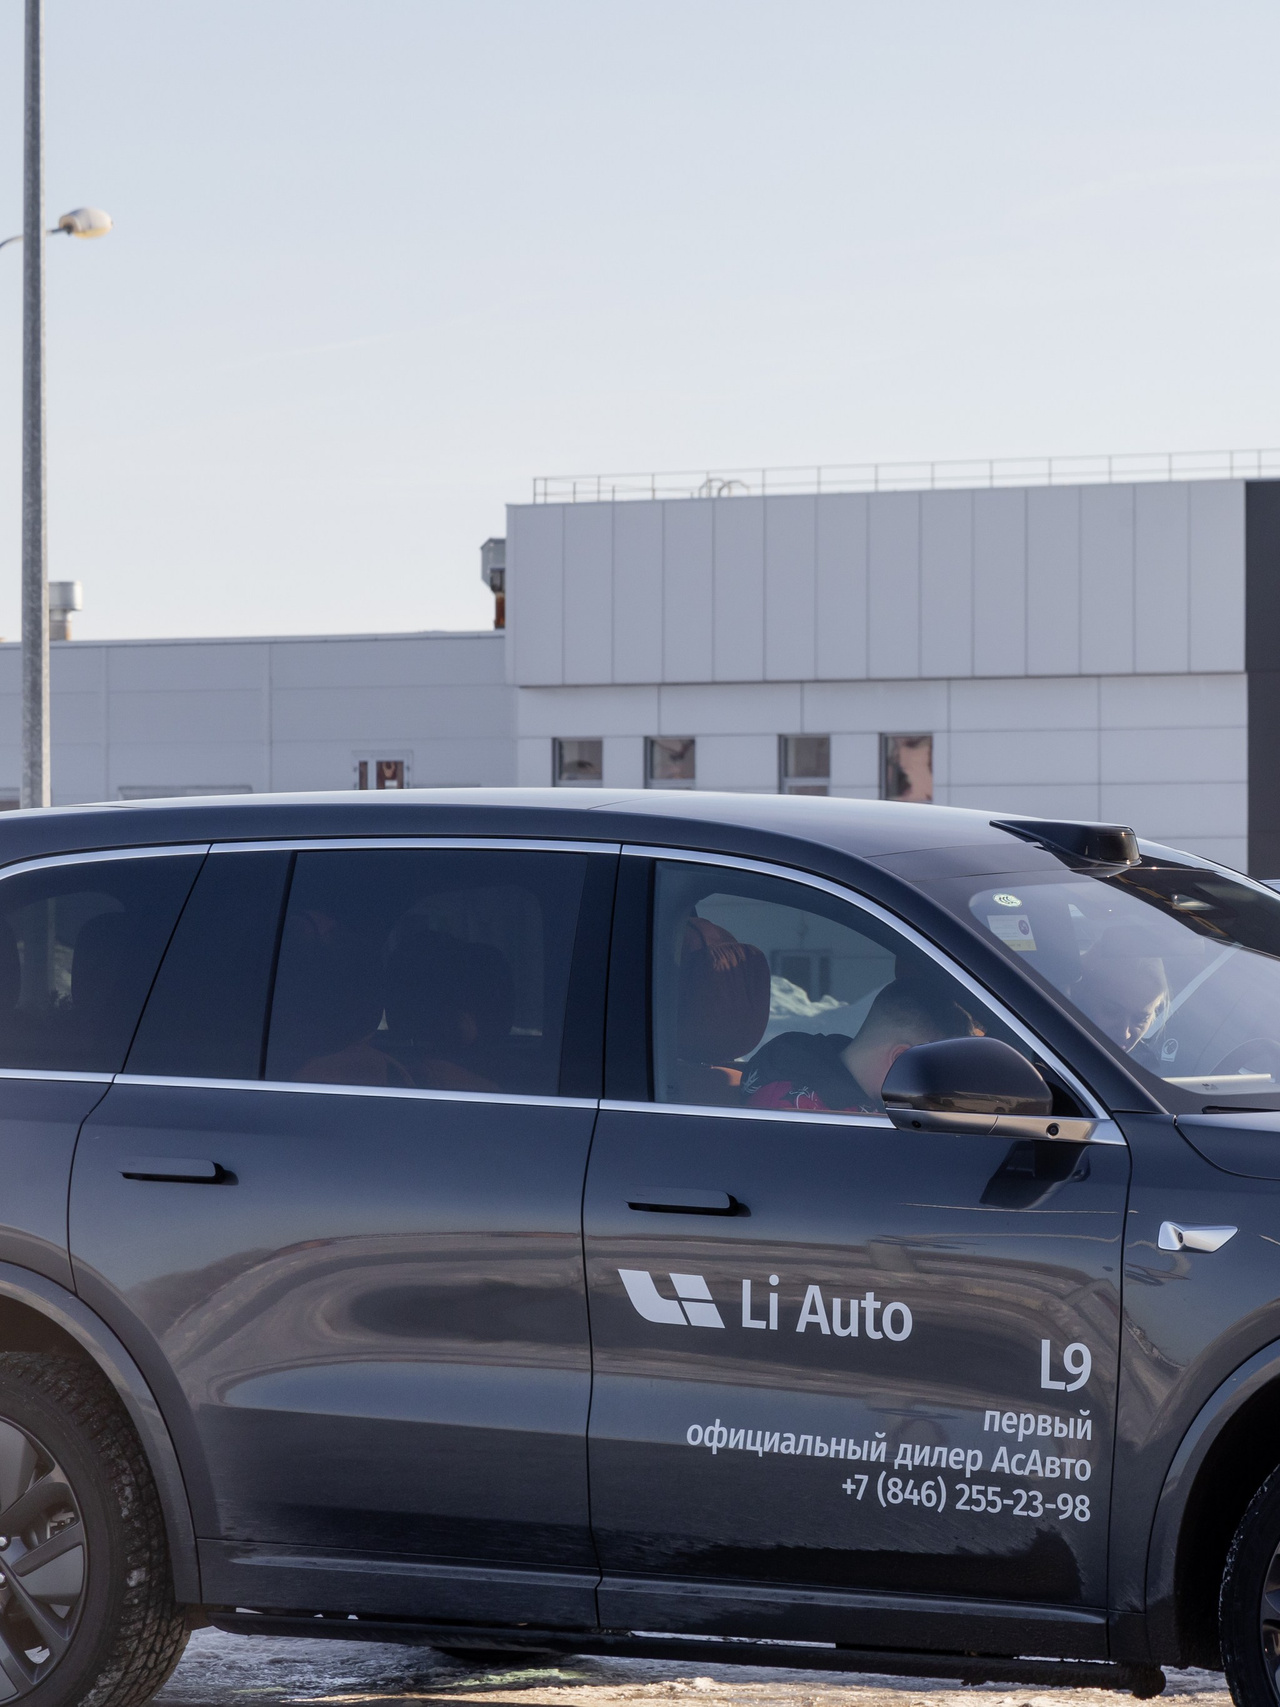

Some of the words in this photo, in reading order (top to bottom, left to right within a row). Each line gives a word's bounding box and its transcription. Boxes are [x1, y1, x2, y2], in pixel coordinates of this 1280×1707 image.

[742, 1274, 779, 1330] Li
[796, 1284, 913, 1342] Auto
[1040, 1339, 1092, 1392] L9
[686, 1419, 886, 1462] официальный
[894, 1442, 983, 1477] дилер
[991, 1447, 1092, 1481] АсАвто
[984, 1409, 1092, 1441] первый
[842, 1475, 868, 1501] +7
[877, 1471, 947, 1513] (846)
[955, 1483, 1091, 1522] 255-23-98
